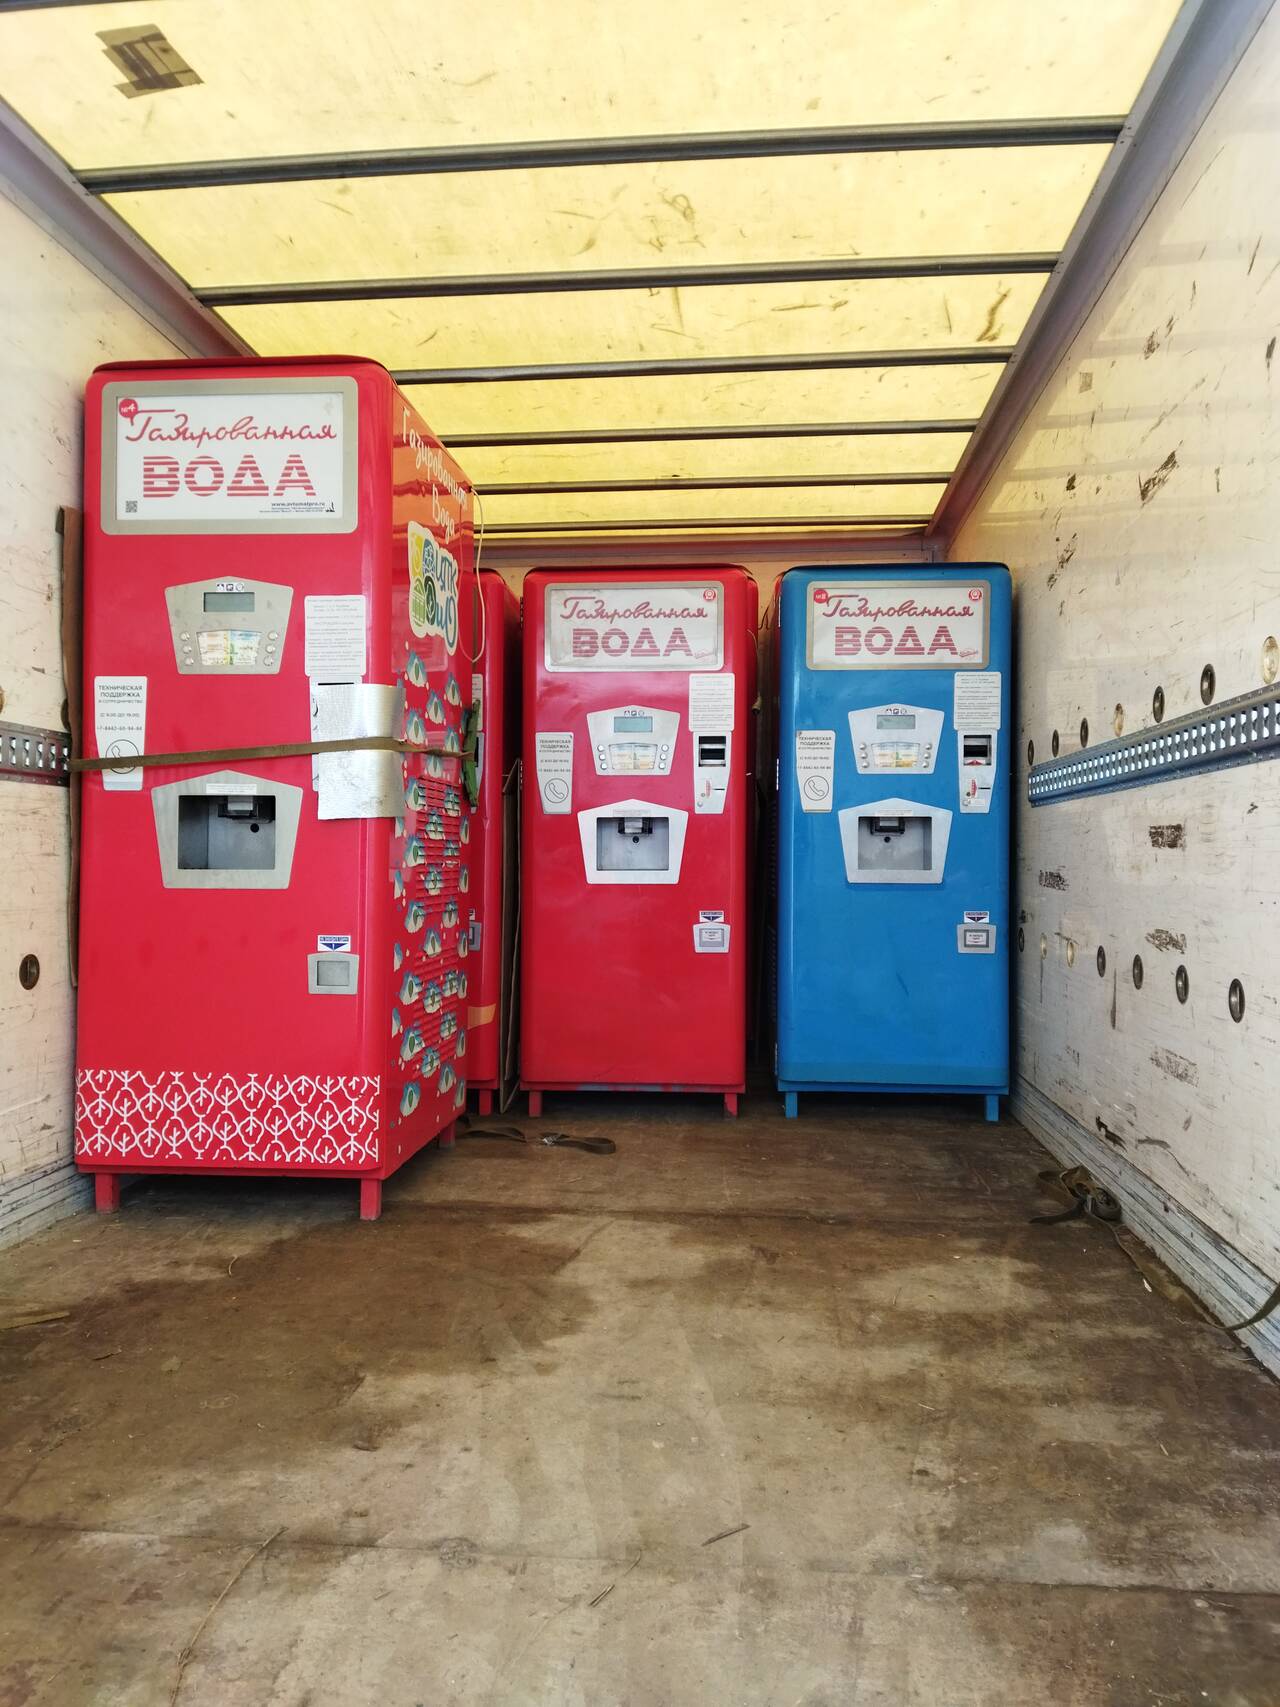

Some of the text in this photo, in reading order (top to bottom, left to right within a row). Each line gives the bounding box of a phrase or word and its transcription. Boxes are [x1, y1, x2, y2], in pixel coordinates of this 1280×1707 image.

[125, 409, 337, 448] Газированная
[143, 453, 317, 498] ВОДА
[432, 483, 455, 544] Вода
[560, 596, 708, 624] Газированная
[822, 594, 975, 622] Газированная
[571, 627, 693, 658] ВОДА
[834, 625, 959, 656] ВОДА
